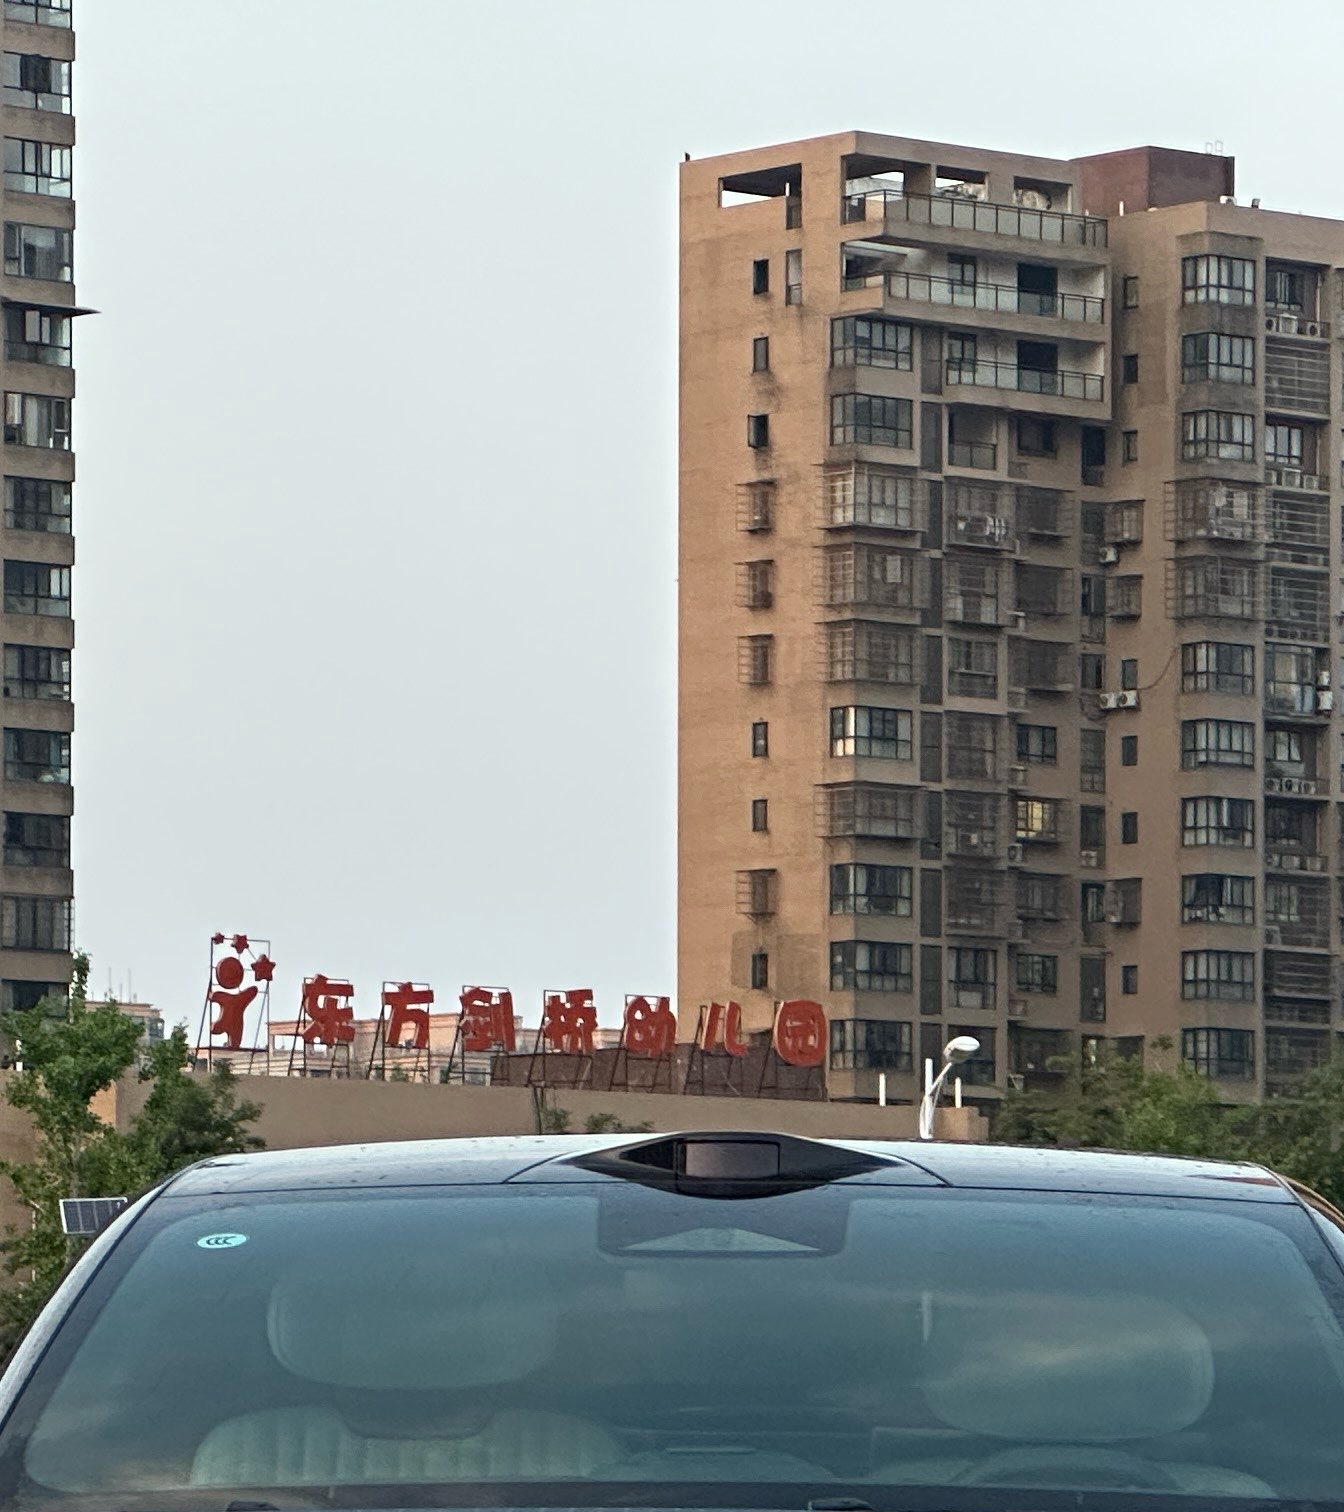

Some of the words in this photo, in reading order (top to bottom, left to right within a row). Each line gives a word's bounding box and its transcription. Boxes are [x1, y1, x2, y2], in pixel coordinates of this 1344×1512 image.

[302, 973, 828, 1067] 东方剑桥幼儿园
